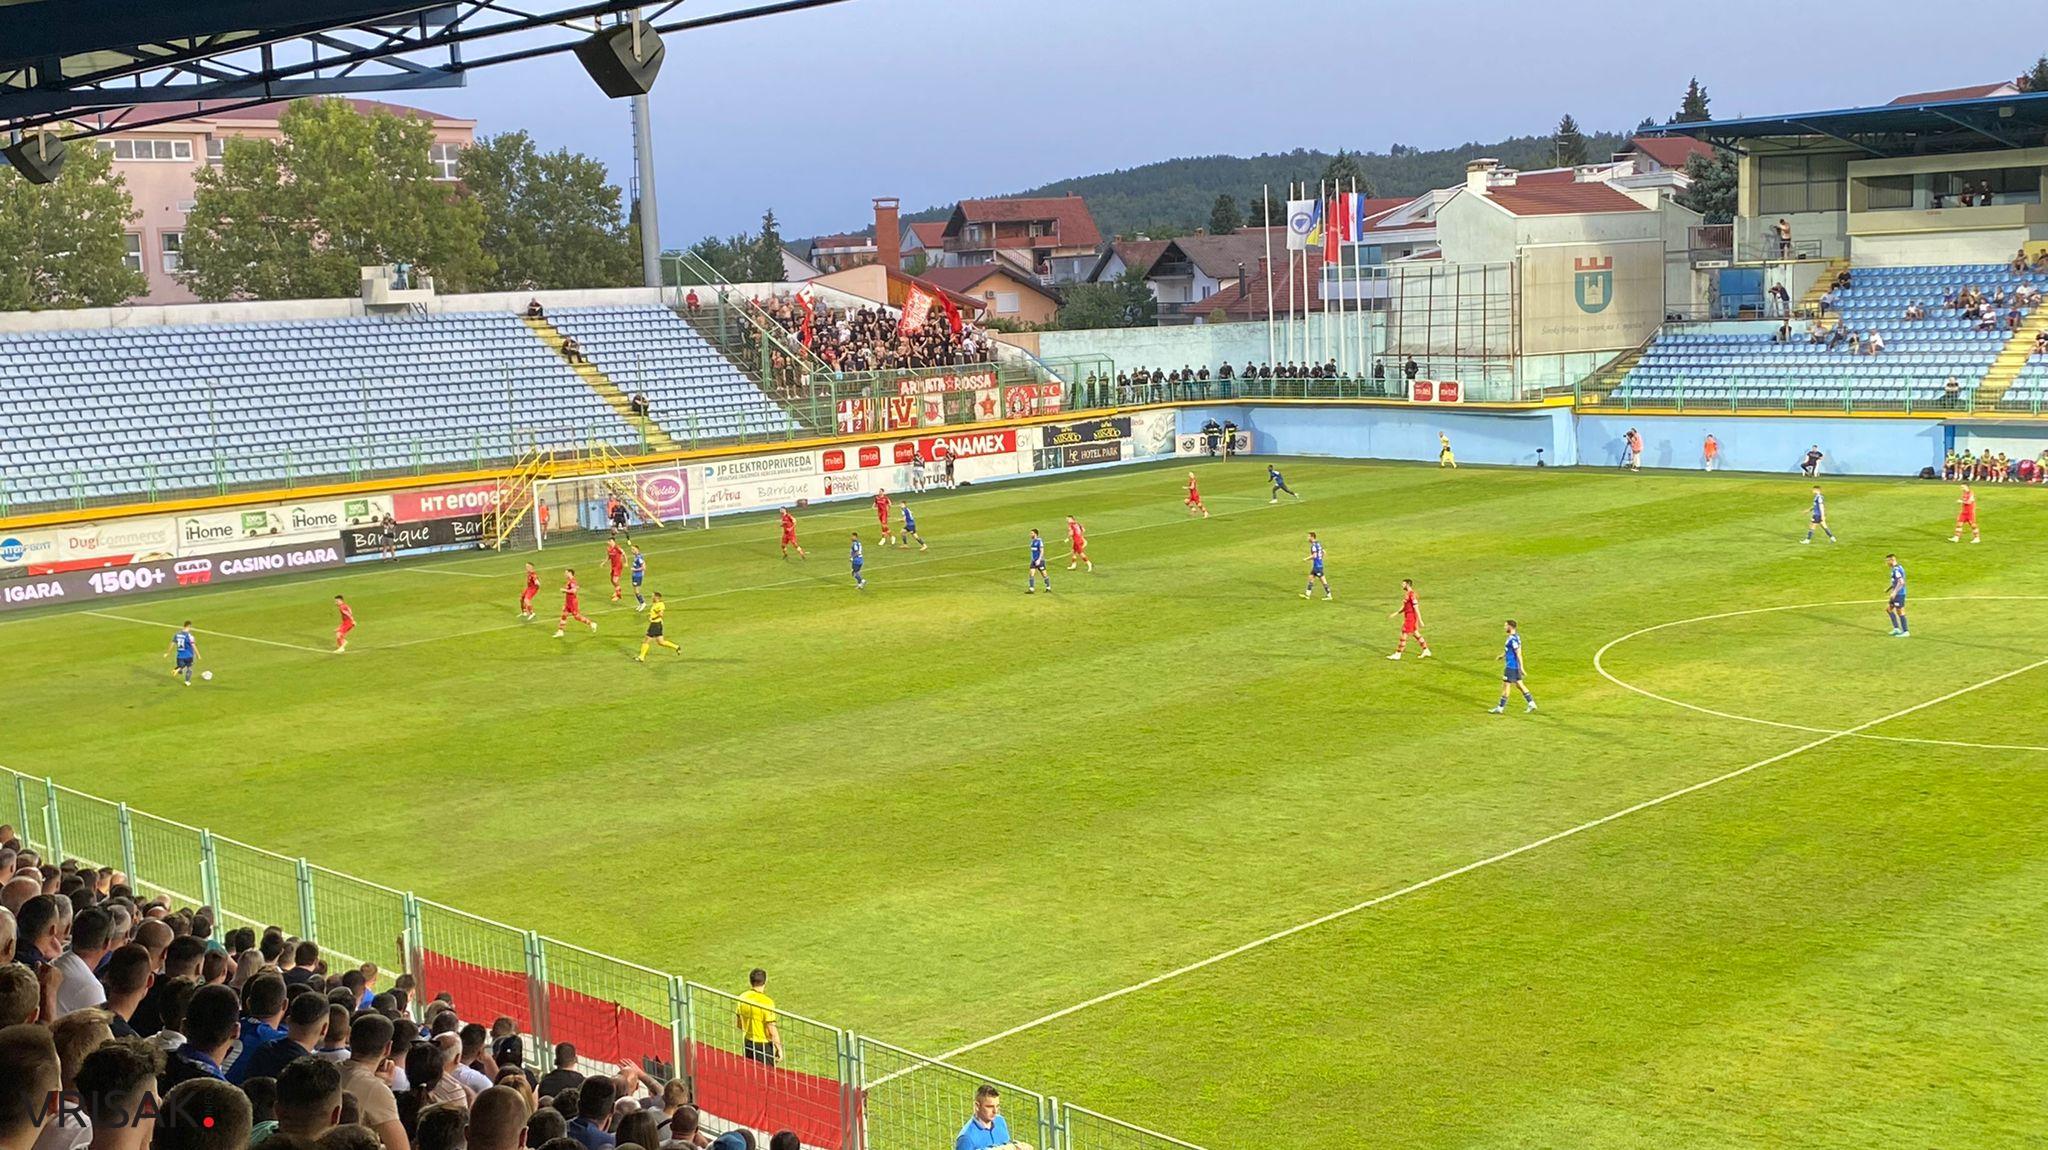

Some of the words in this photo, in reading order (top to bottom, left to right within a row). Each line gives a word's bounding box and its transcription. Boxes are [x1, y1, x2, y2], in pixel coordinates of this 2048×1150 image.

[954, 373, 991, 391] ROSSA
[1081, 448, 1101, 460] HOTEL
[1102, 446, 1118, 457] PARK
[717, 464, 727, 476] JP
[729, 456, 812, 474] ELEKTROPRIVREDA
[420, 495, 444, 512] HT
[704, 488, 741, 504] aViva
[292, 512, 337, 528] iHome
[186, 525, 233, 541] iHome
[352, 527, 430, 548] Barique
[178, 562, 209, 572] BAR
[219, 553, 285, 575] CASINO
[286, 547, 339, 567] IGARA
[88, 567, 166, 594] 1500+
[4, 581, 65, 603] IGARA
